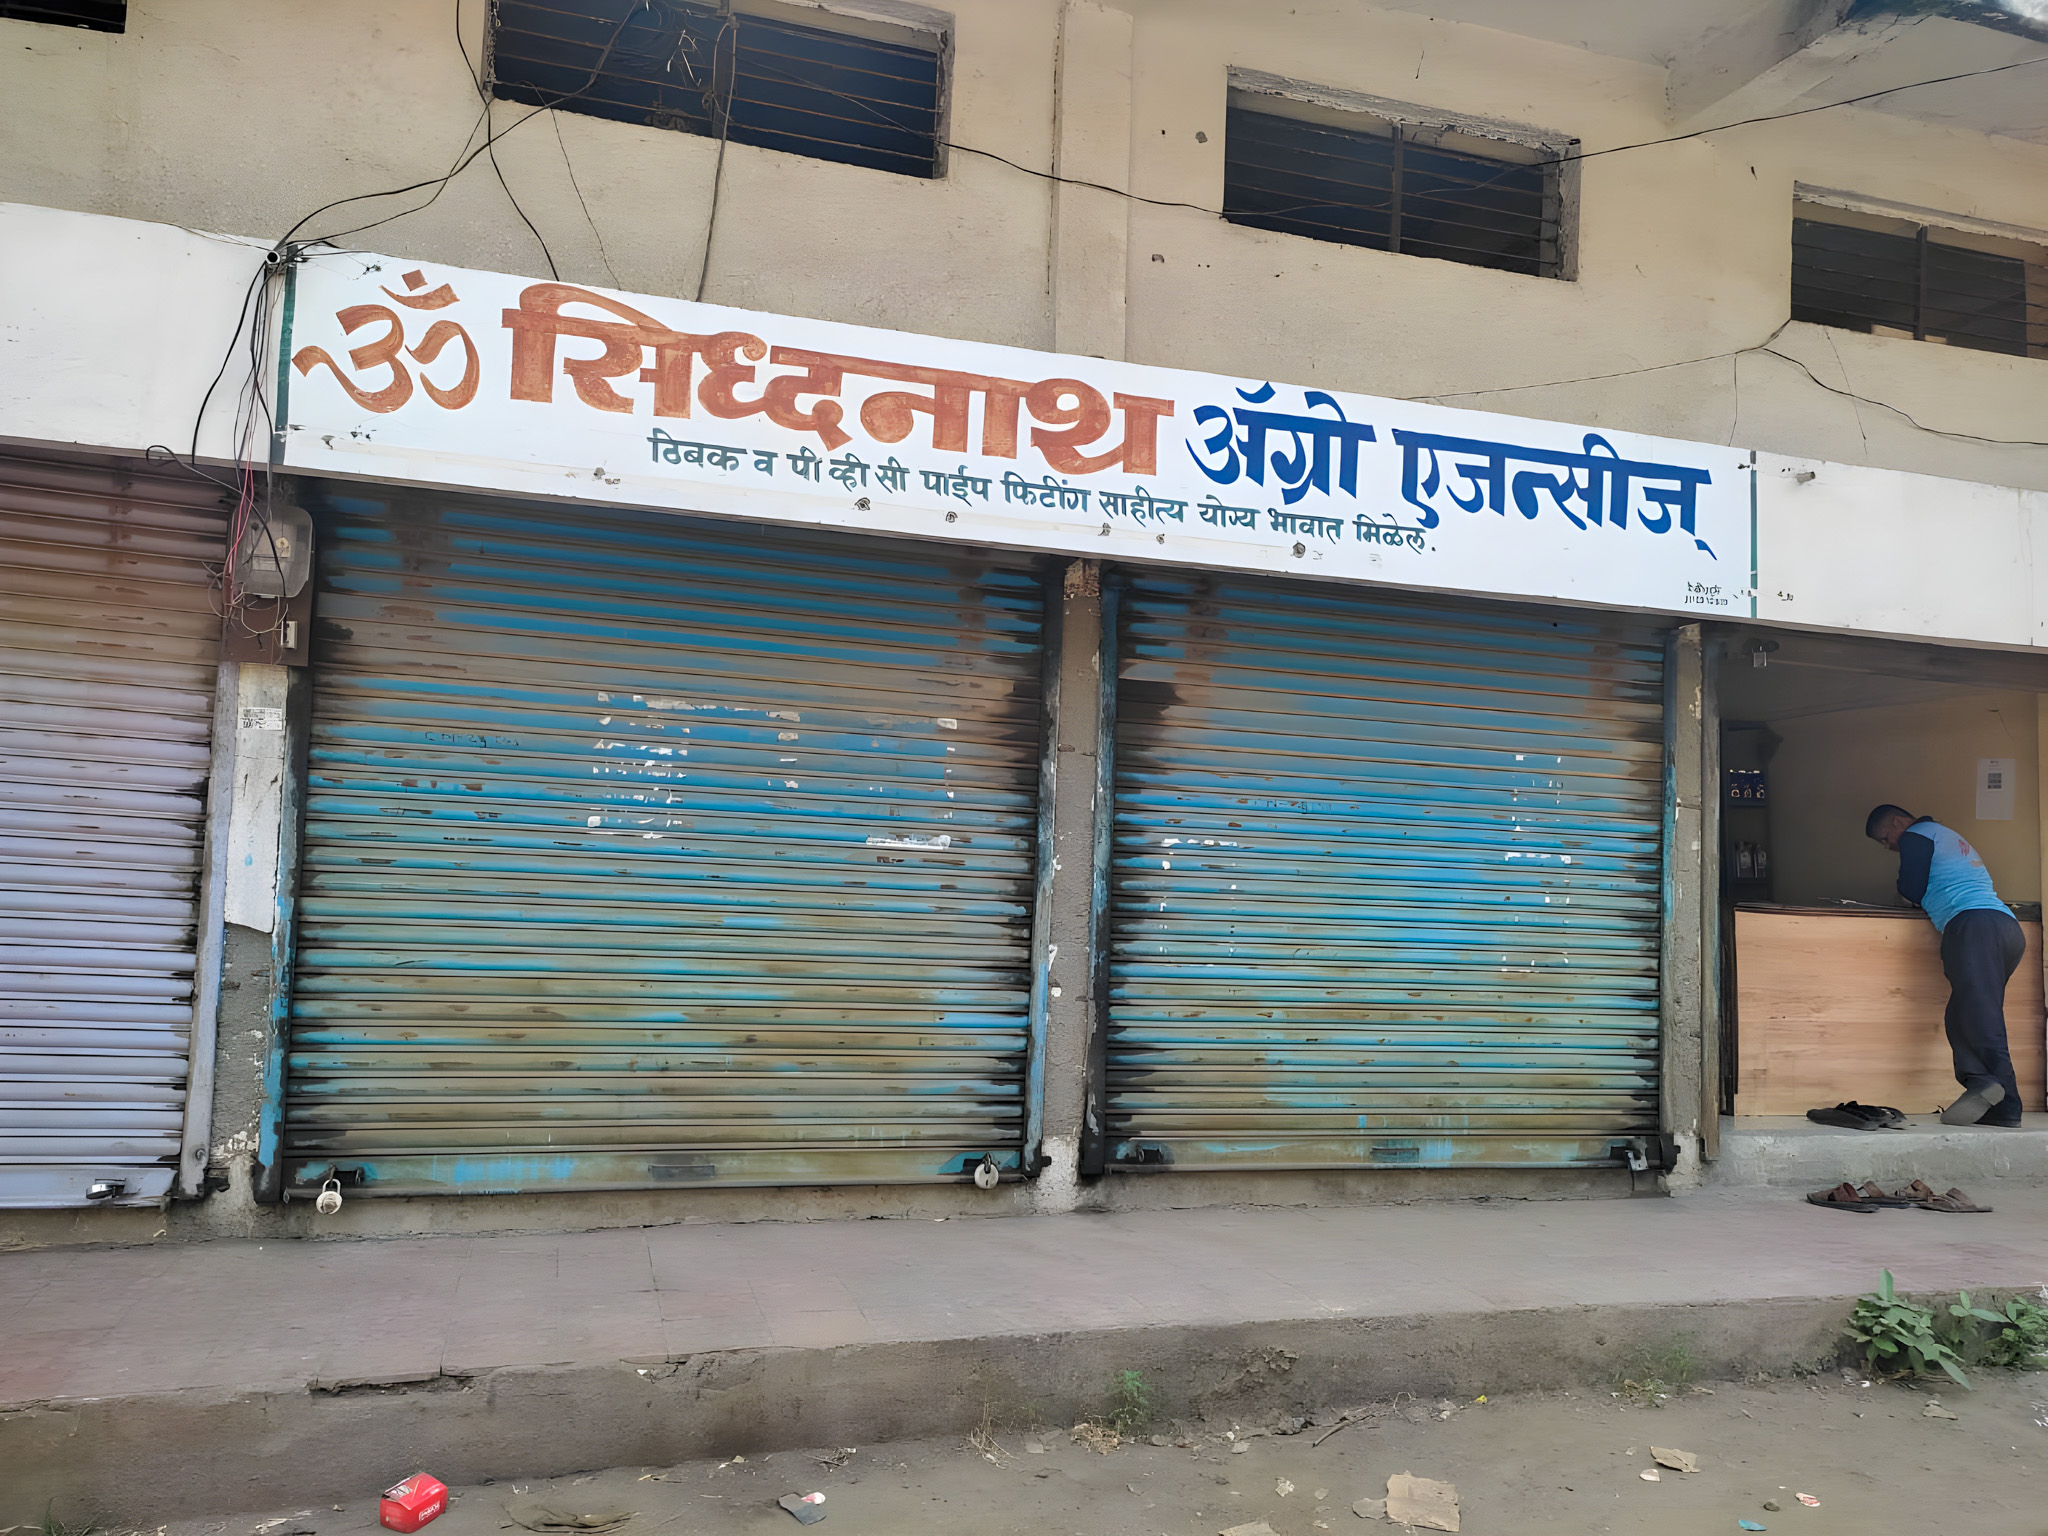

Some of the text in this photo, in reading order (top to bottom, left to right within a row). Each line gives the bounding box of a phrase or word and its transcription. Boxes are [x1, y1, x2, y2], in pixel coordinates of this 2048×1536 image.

[647, 427, 748, 471] ठिबक
[753, 449, 779, 477] व
[786, 446, 823, 483] पी
[828, 452, 870, 493] व्ही
[875, 456, 910, 493] सी
[919, 464, 992, 507] पाईप
[1000, 471, 1091, 512] फिटींग
[1099, 485, 1188, 527] साहीत्य
[1197, 494, 1261, 531] योग्य
[1267, 508, 1345, 545] भावात
